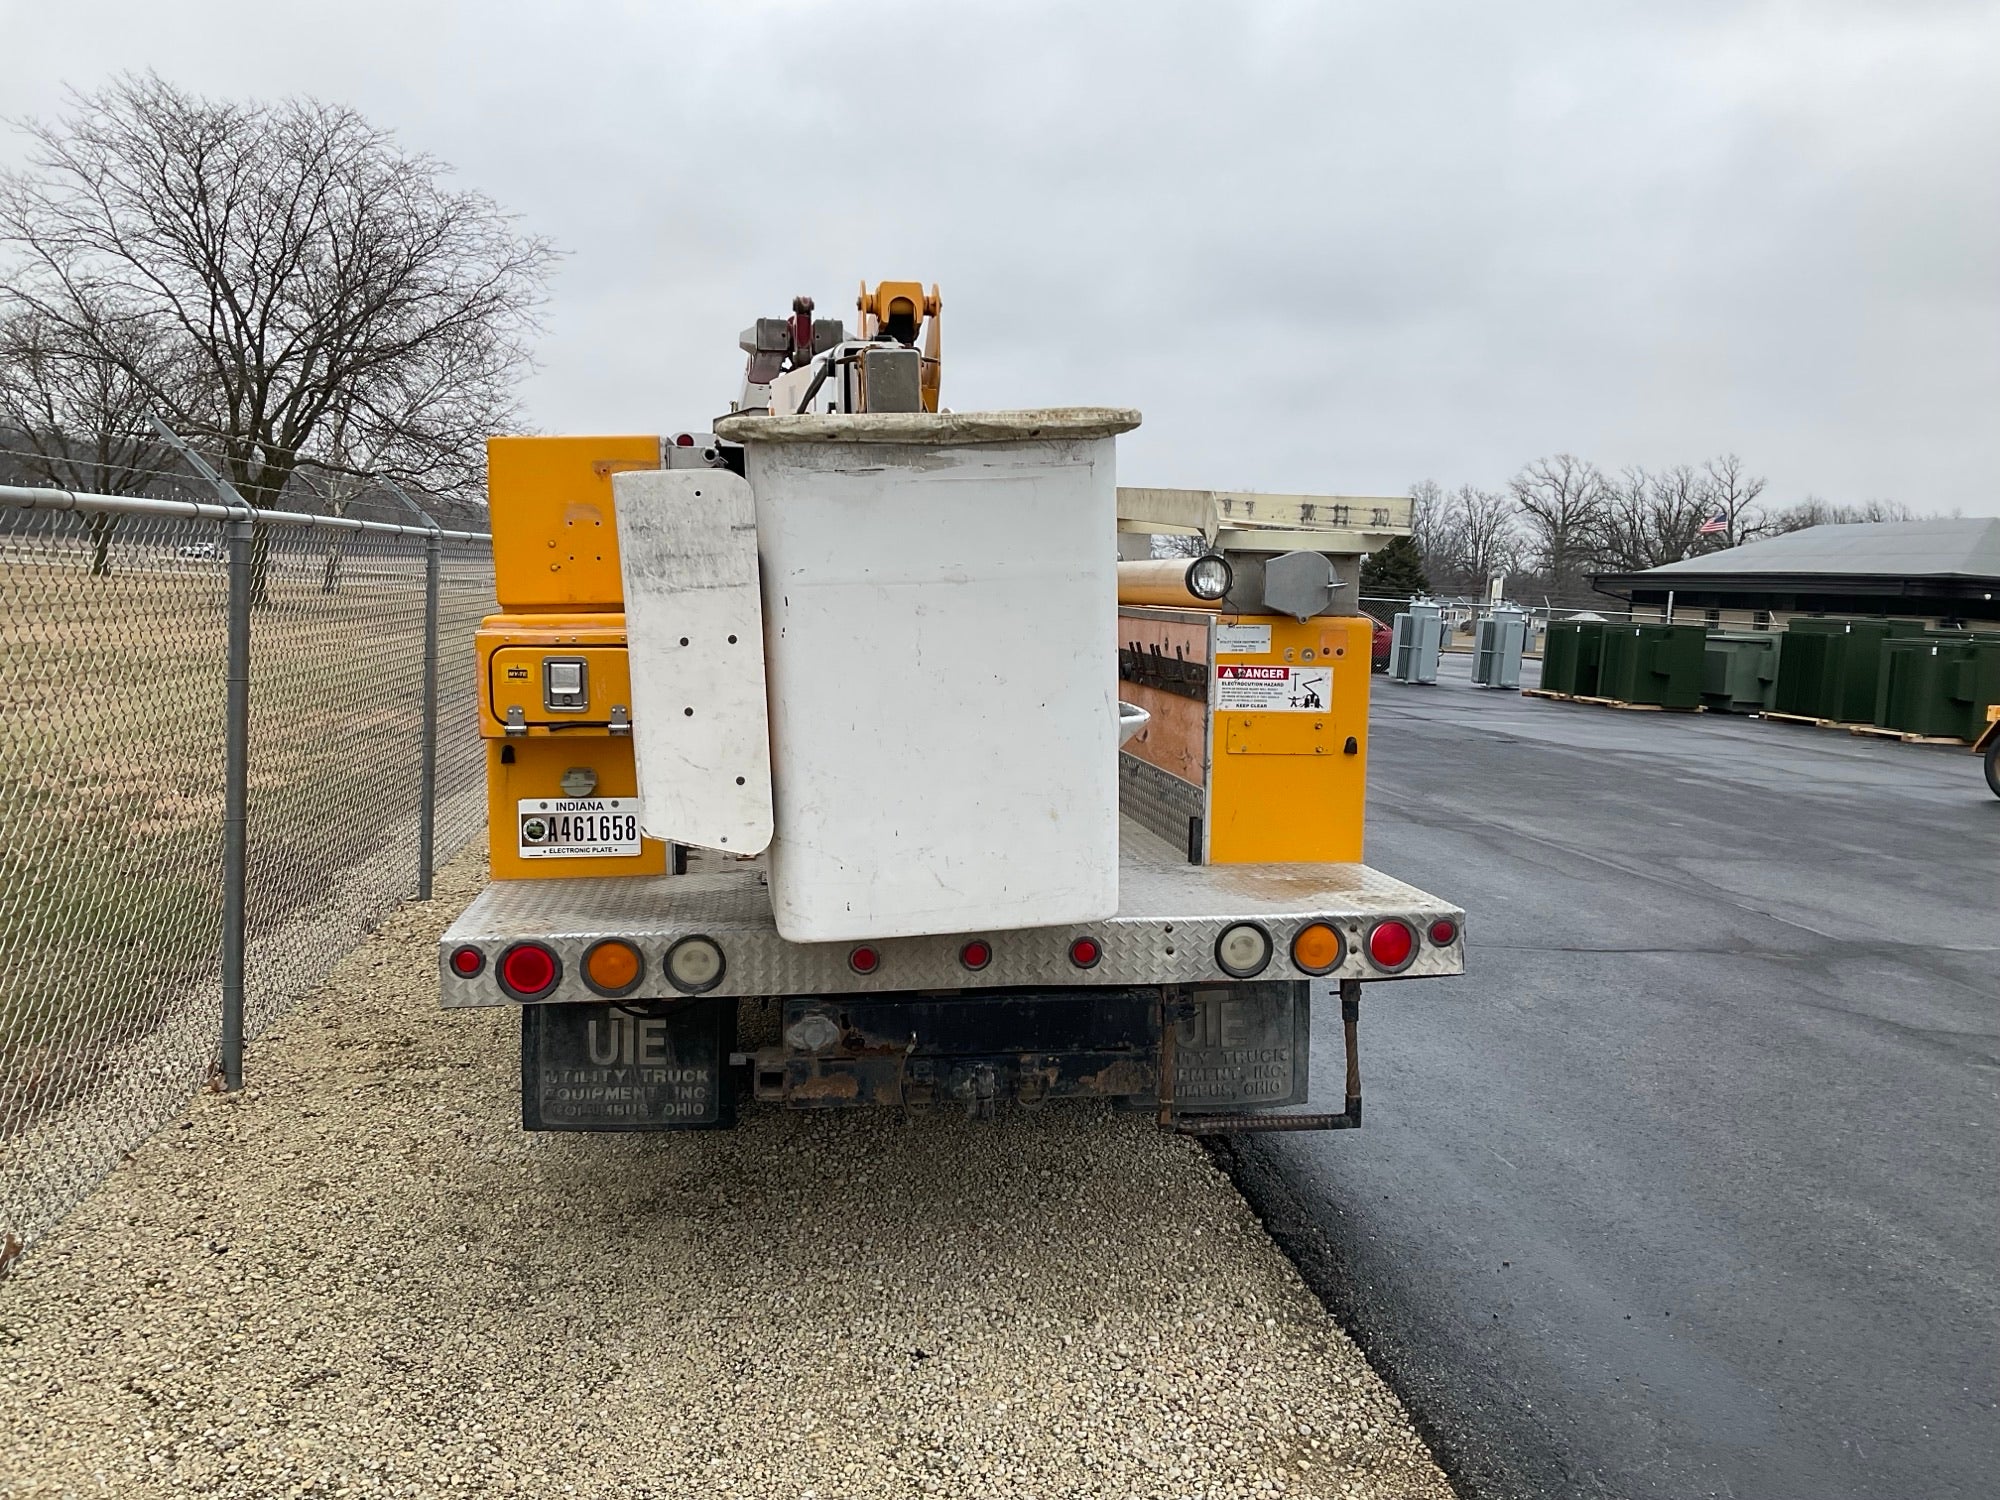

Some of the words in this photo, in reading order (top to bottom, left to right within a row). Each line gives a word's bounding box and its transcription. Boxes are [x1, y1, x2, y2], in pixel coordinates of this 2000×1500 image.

[1237, 668, 1285, 679] DANGER
[556, 801, 605, 812] INDIANA
[548, 815, 637, 843] A461658
[1221, 1048, 1289, 1065] TRUCK
[544, 1069, 627, 1084] UTILITY
[641, 1069, 710, 1084] TRUCK
[1243, 1080, 1281, 1096] OHIO
[663, 1102, 706, 1117] OHIO
